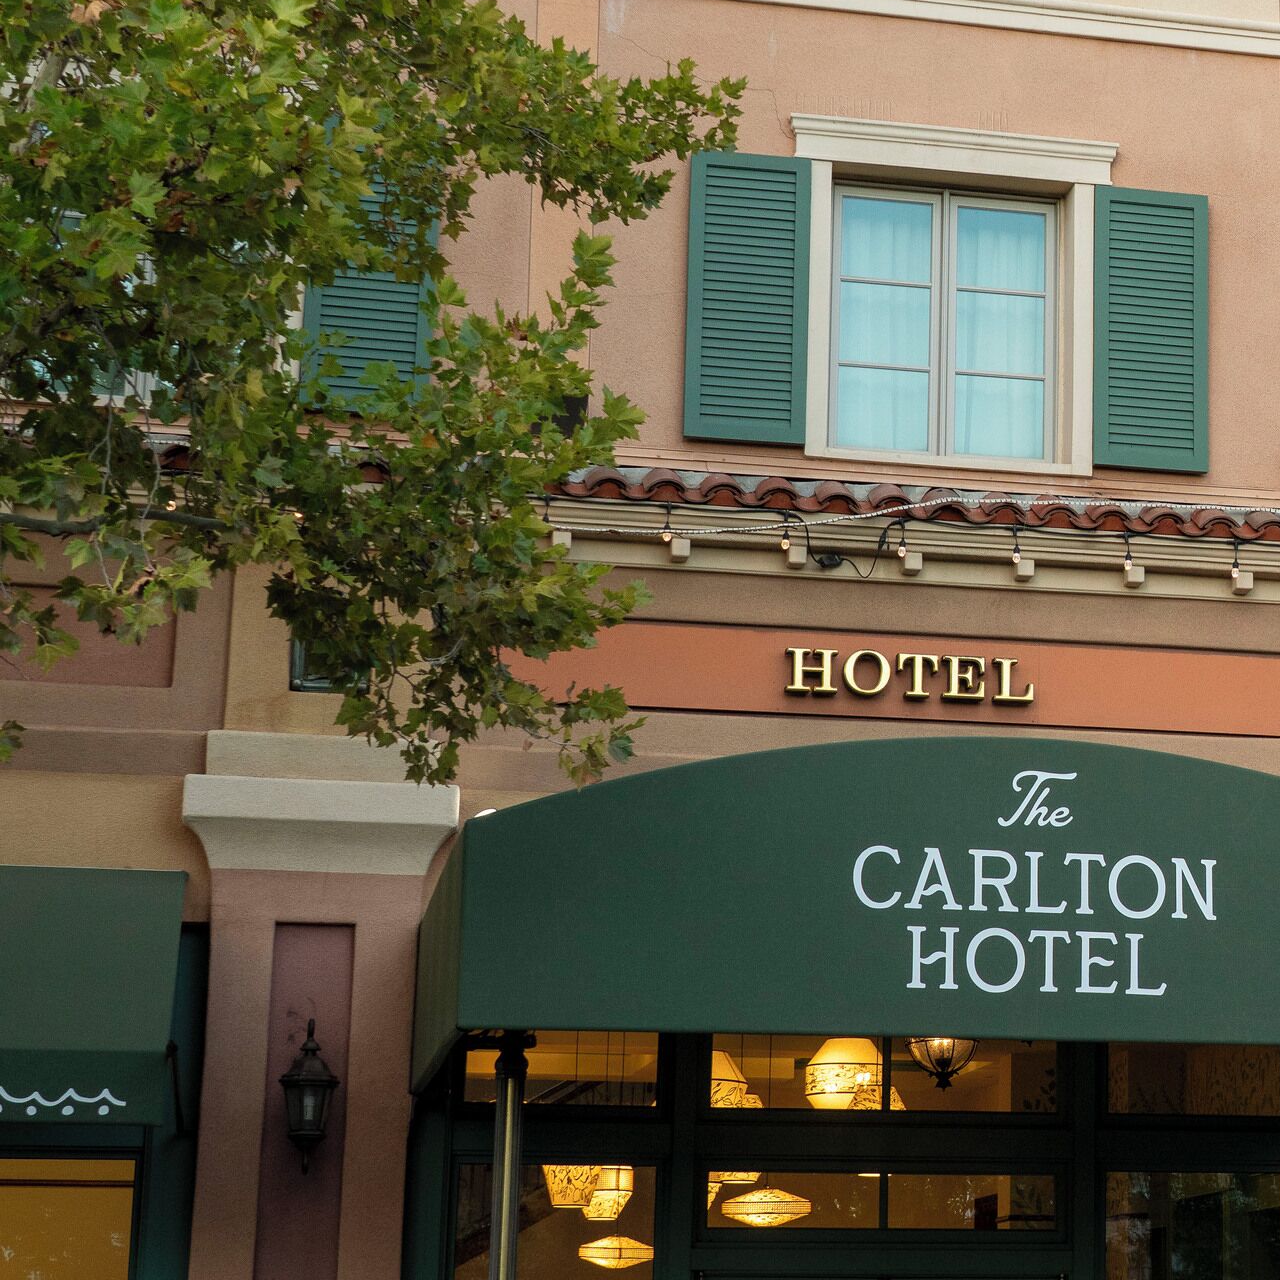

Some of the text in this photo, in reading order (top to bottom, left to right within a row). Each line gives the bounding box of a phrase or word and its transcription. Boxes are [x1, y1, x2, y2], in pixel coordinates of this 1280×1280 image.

[785, 647, 1035, 705] HOTEL
[998, 770, 1077, 827] The
[853, 845, 1217, 921] CARLTON
[906, 926, 1168, 996] HOTEL
